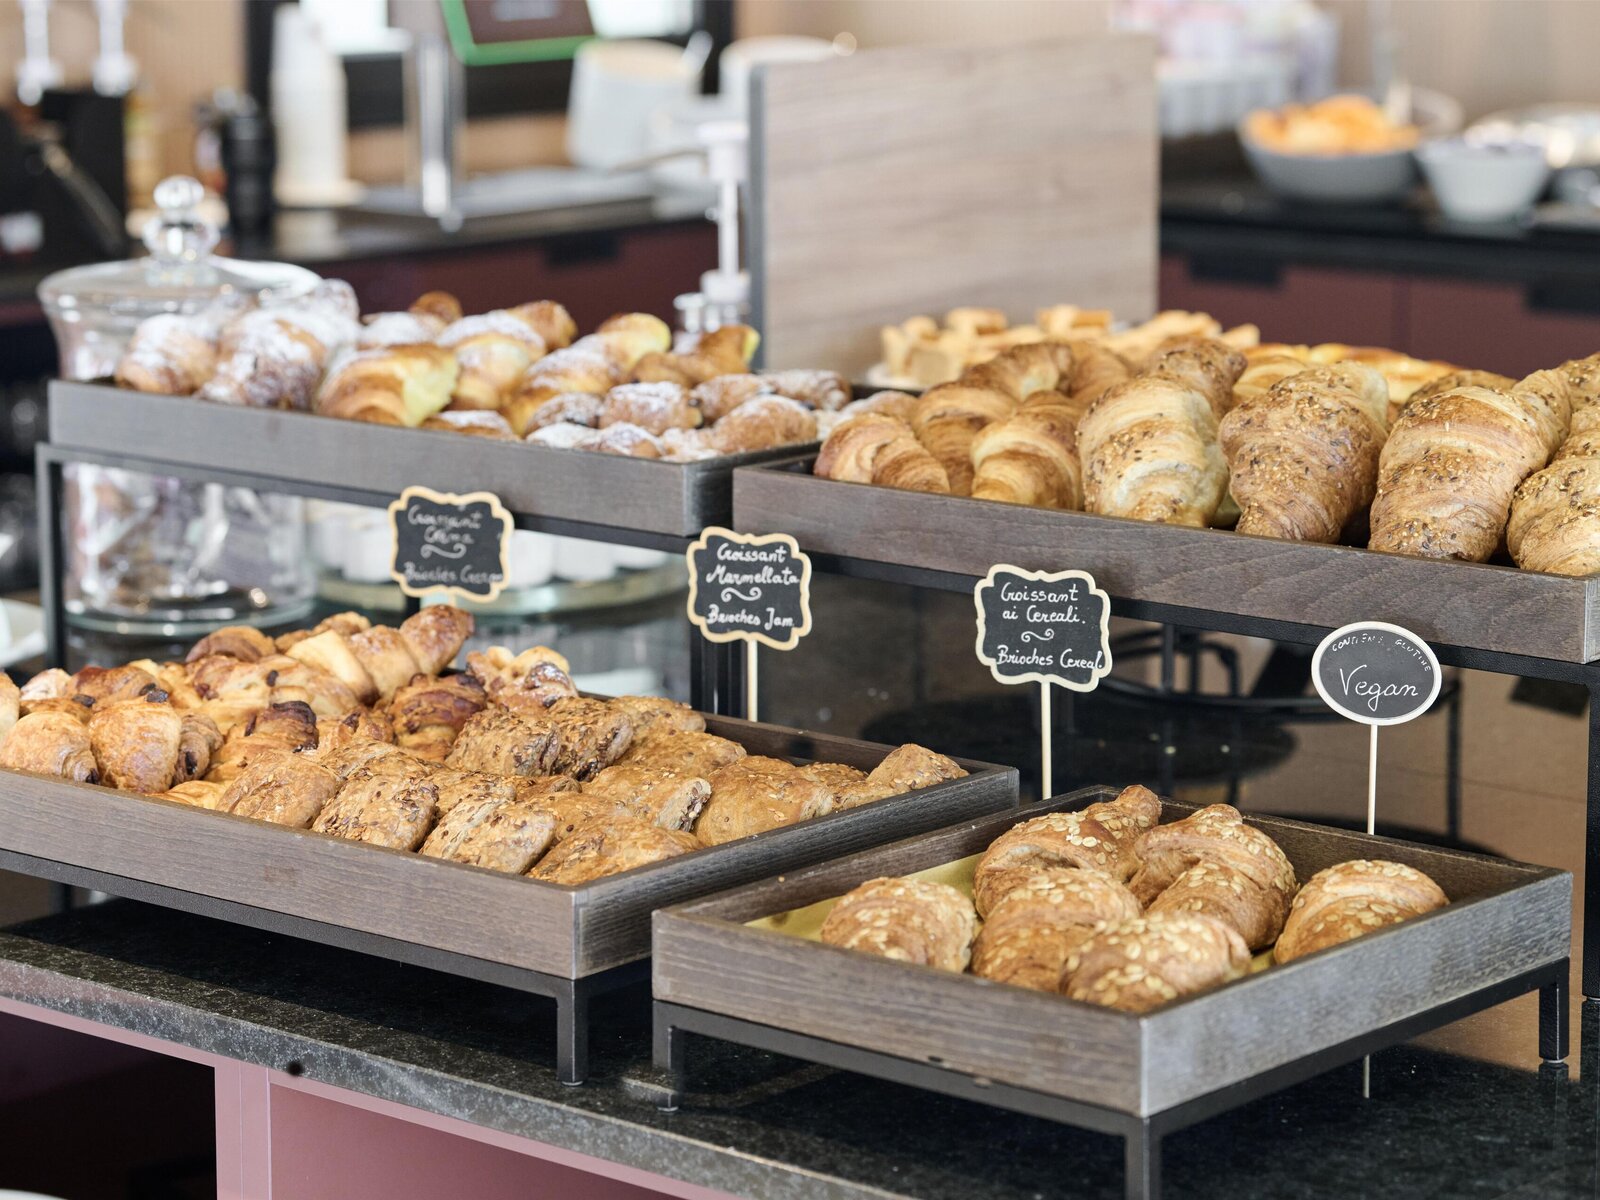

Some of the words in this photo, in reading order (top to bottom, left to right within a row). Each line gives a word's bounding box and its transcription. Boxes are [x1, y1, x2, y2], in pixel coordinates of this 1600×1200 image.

[717, 542, 787, 563] Croissant
[706, 564, 800, 585] Marmellata
[1000, 582, 1079, 603] Croissant
[1002, 605, 1019, 620] ai
[997, 644, 1054, 666] Brioches
[1339, 664, 1419, 712] Vegan
